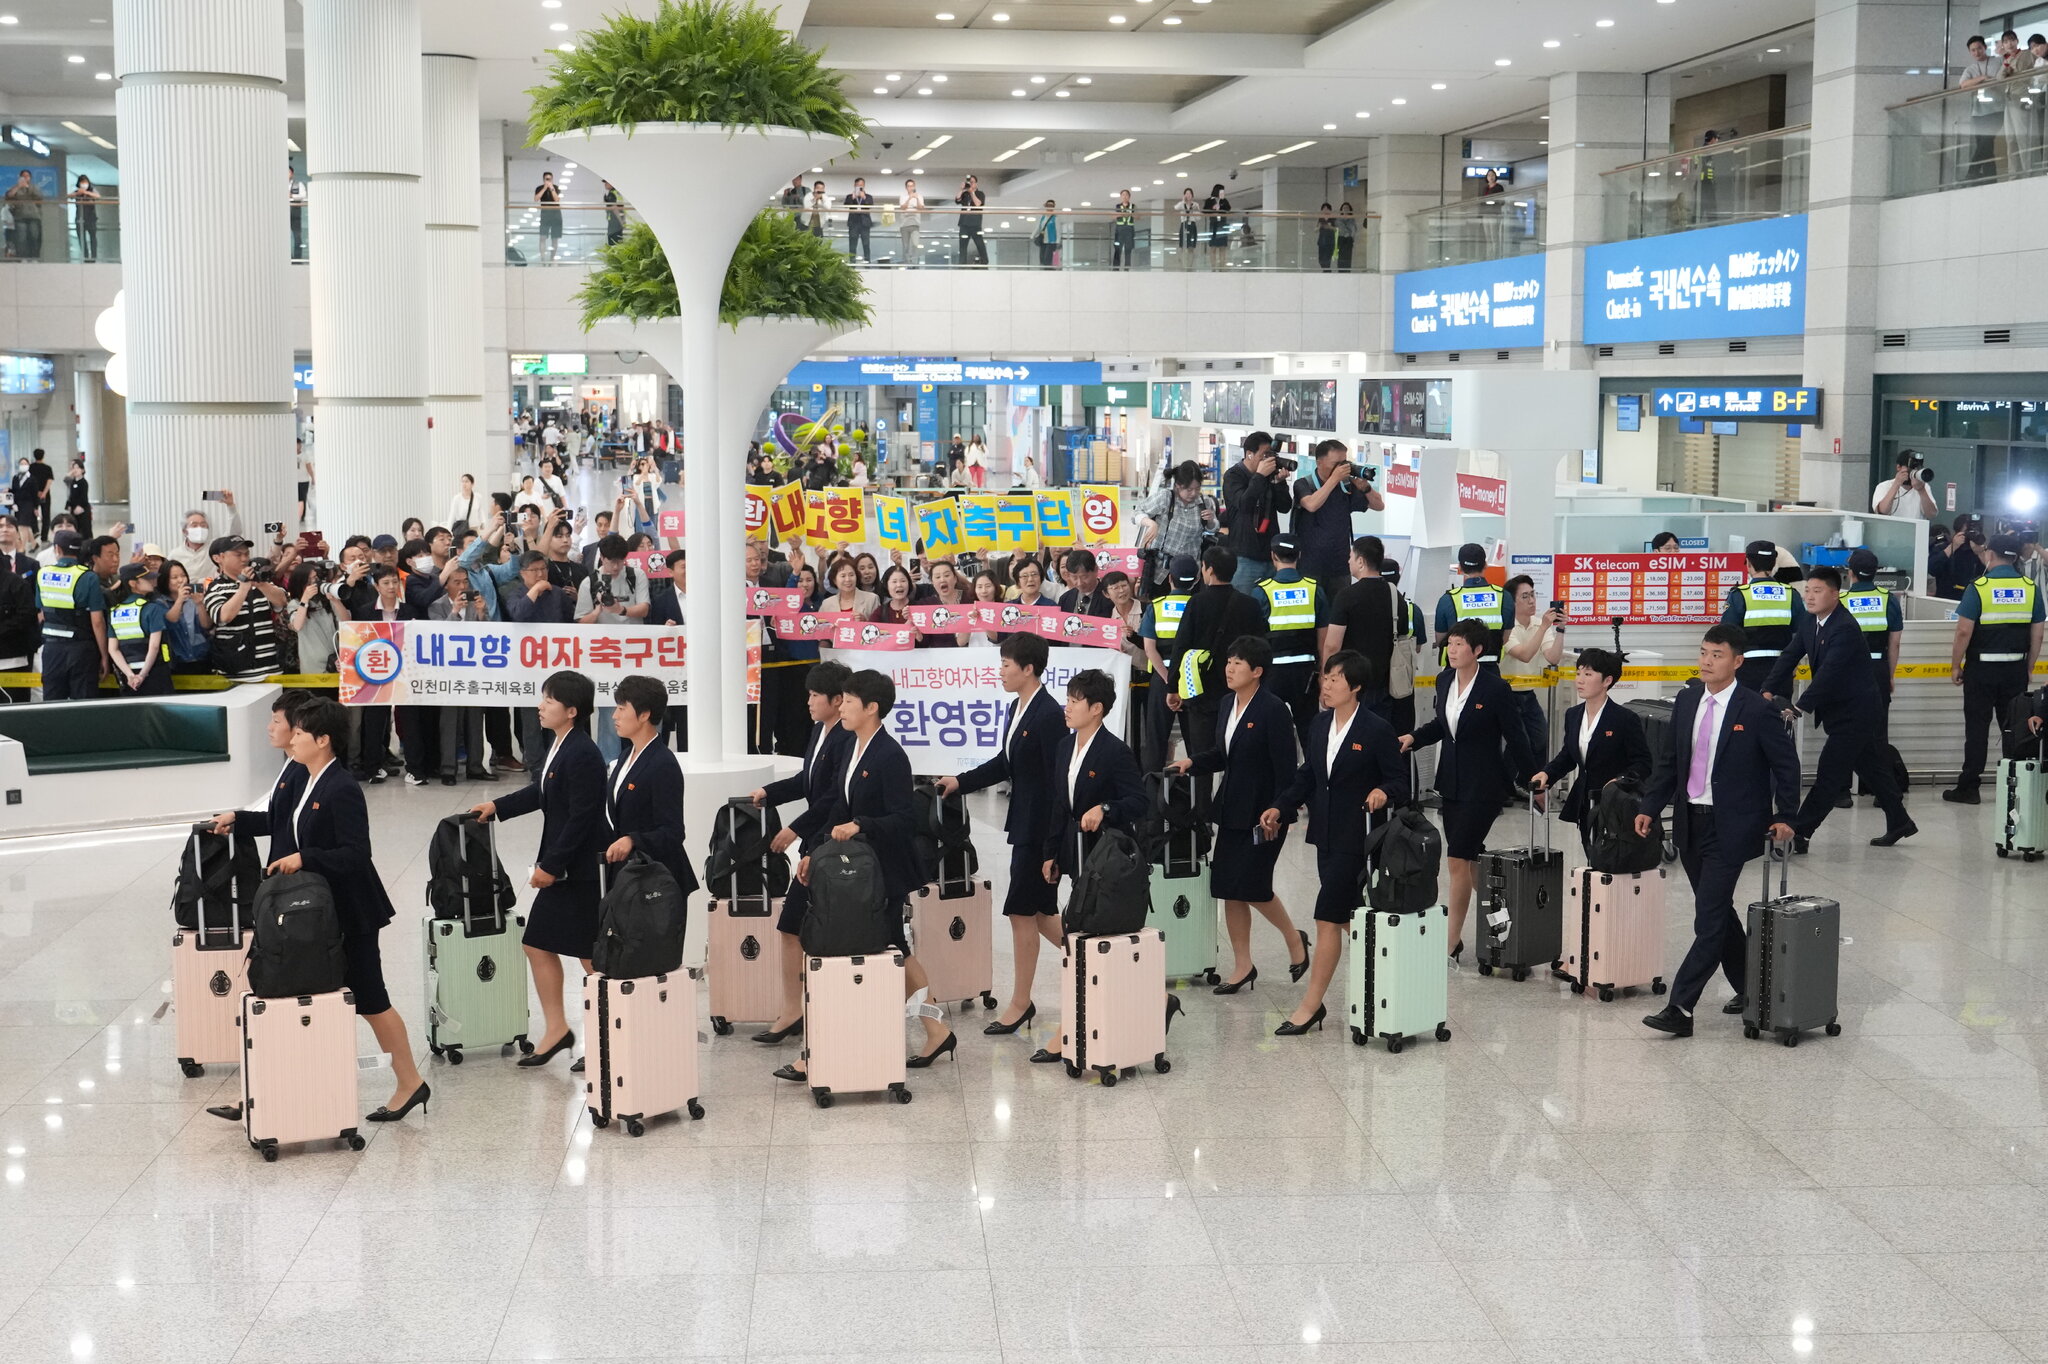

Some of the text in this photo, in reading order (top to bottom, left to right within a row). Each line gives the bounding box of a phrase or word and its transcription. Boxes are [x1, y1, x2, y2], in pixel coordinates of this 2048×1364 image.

[1606, 266, 1644, 290] Domestic
[1649, 263, 1722, 310] 국내선수속
[1440, 289, 1490, 327] 국내선수속
[1606, 297, 1642, 319] Check-in
[1773, 391, 1808, 411] B-F
[1459, 483, 1471, 498] Free
[664, 516, 680, 531] 환
[1085, 499, 1113, 531] 영
[1126, 554, 1140, 570] 영
[1573, 556, 1728, 570] SK telecom eSIM SIM
[786, 594, 801, 609] 영
[912, 612, 927, 628] 환
[980, 609, 996, 624] 환
[1687, 615, 1716, 623] T-money
[780, 619, 795, 634] 환
[839, 626, 910, 645] 환 영
[1042, 617, 1118, 640] 환 영
[416, 633, 687, 669] 내고향 여자 축구단
[367, 650, 391, 674] 환
[410, 679, 536, 696] 인천미추홀구체육회
